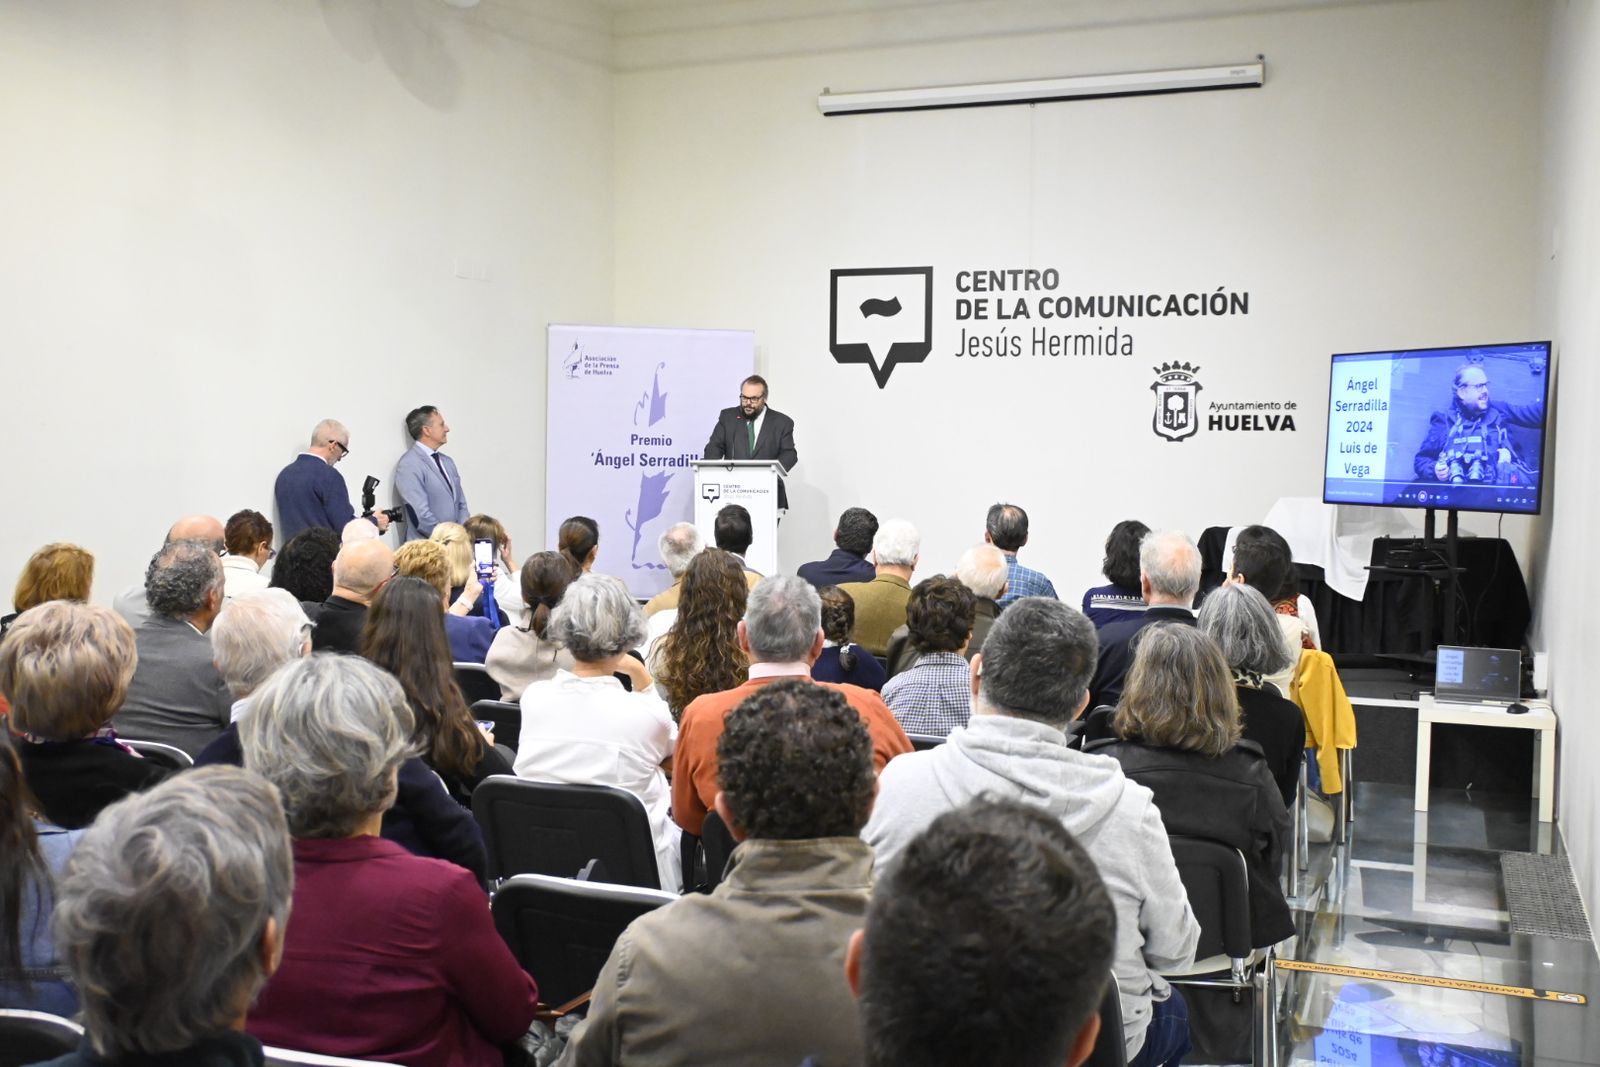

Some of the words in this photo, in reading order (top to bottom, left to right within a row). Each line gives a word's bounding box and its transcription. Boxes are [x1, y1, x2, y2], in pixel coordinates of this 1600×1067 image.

[955, 268, 1060, 293] CENTRO
[955, 298, 989, 320] DE
[996, 297, 1031, 320] LA
[1038, 286, 1249, 319] COMUNICACIÓN
[955, 326, 1022, 357] Jesús
[1031, 326, 1134, 356] Hermida
[1347, 376, 1378, 394] Ángel
[1209, 401, 1282, 413] Ayuntamiento
[1284, 401, 1297, 410] de
[1335, 398, 1388, 413] Serradilla
[1208, 414, 1297, 432] HUELVA
[1346, 420, 1373, 433] 2024
[630, 433, 673, 447] Premio
[1340, 441, 1361, 454] Luis
[1363, 441, 1378, 454] de
[1344, 462, 1370, 478] Vega
